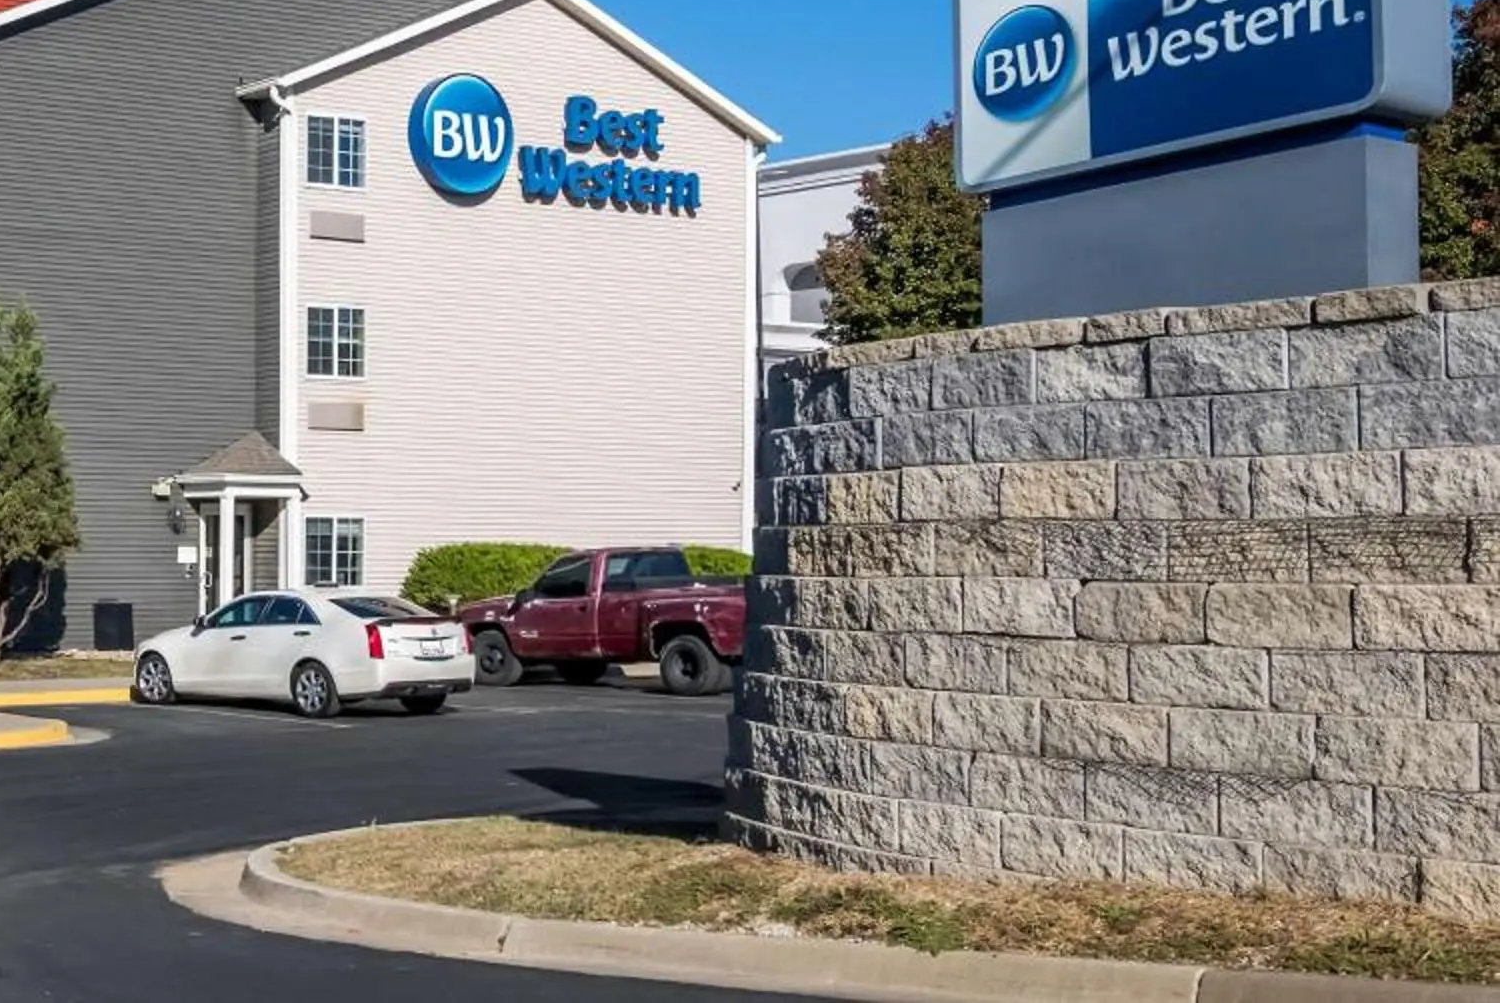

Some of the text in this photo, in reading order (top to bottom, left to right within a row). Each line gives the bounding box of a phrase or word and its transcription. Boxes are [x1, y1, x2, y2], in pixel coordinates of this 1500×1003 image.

[984, 33, 1065, 97] BW
[432, 110, 505, 163] BW
[564, 95, 665, 154] Best
[517, 145, 701, 210] Western
